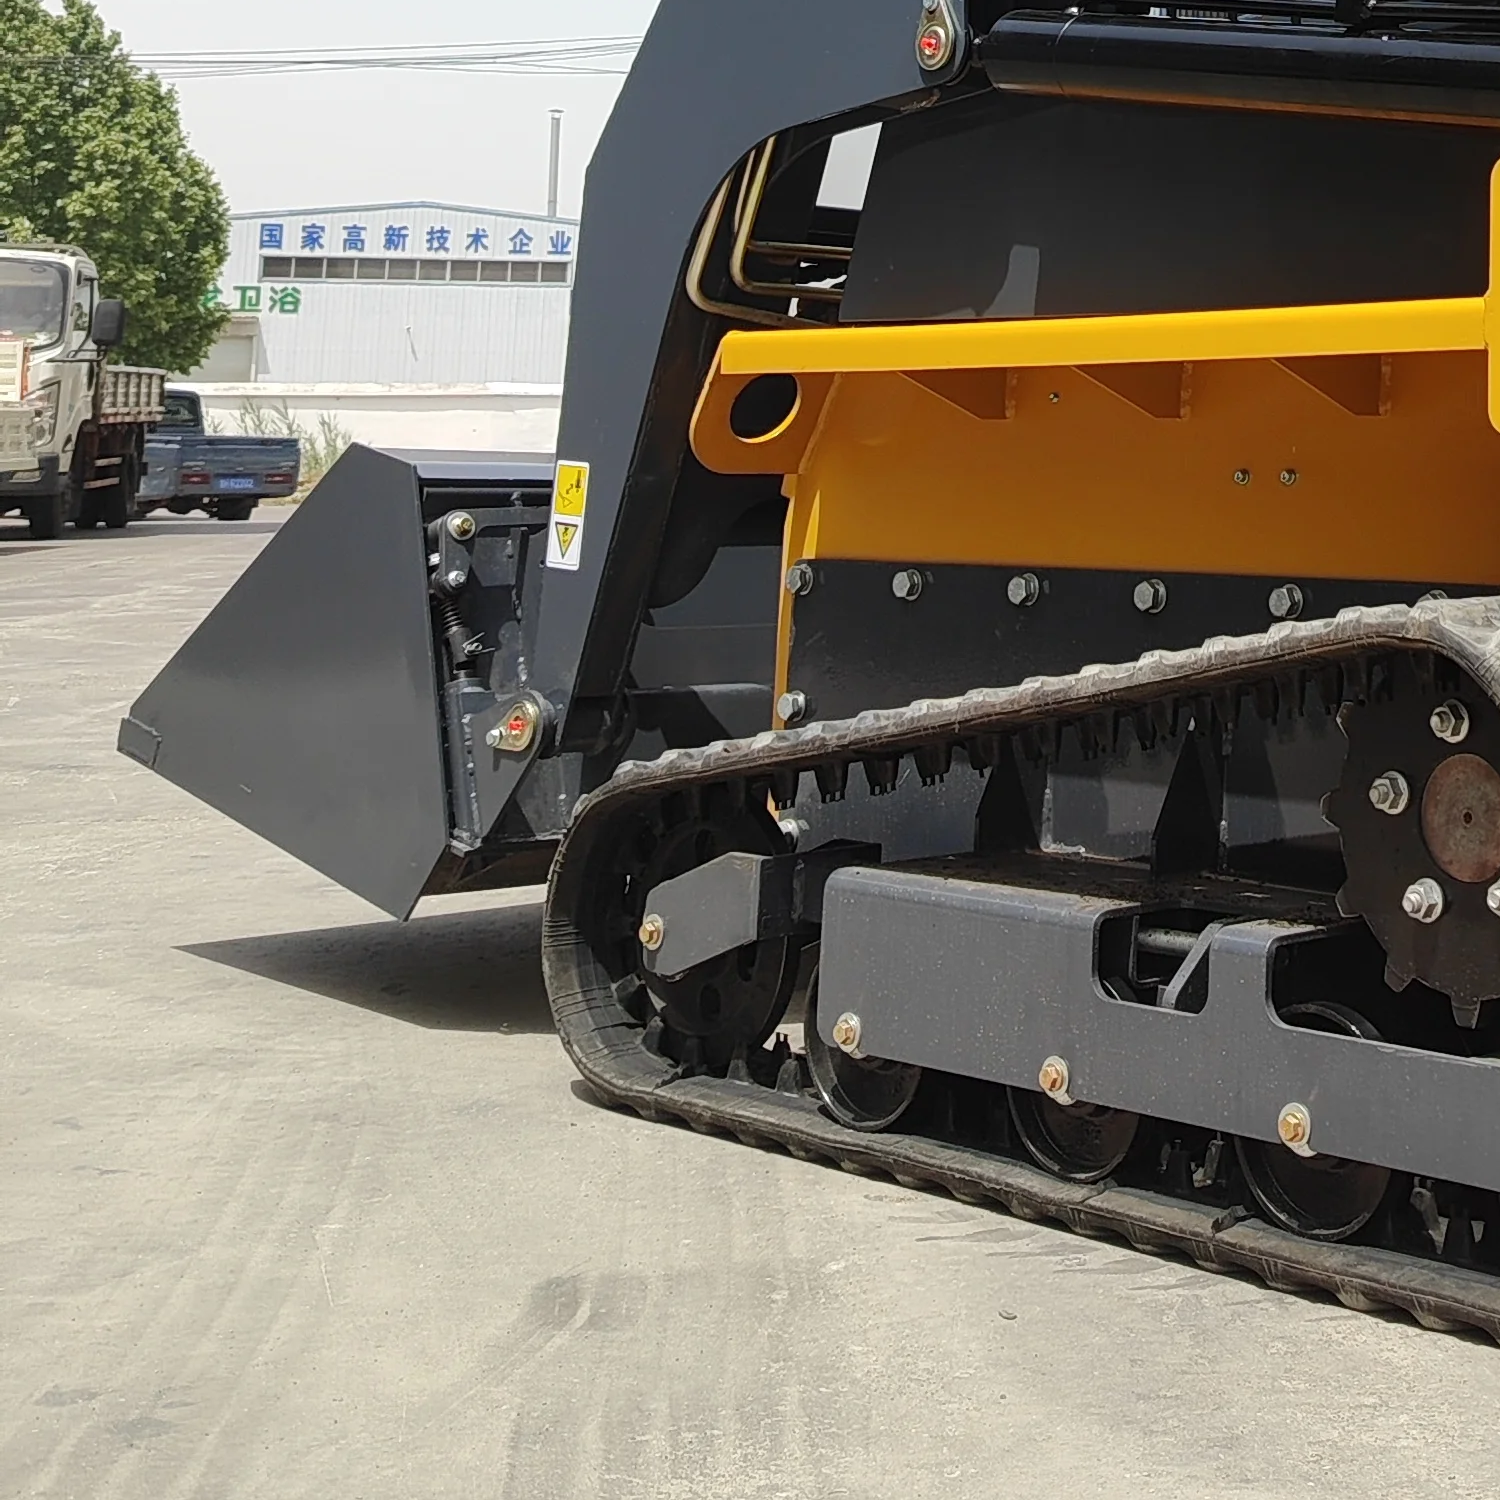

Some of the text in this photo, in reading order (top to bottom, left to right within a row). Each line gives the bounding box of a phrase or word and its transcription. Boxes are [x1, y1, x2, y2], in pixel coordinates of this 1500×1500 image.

[259, 223, 572, 255] 国家高新技术企业
